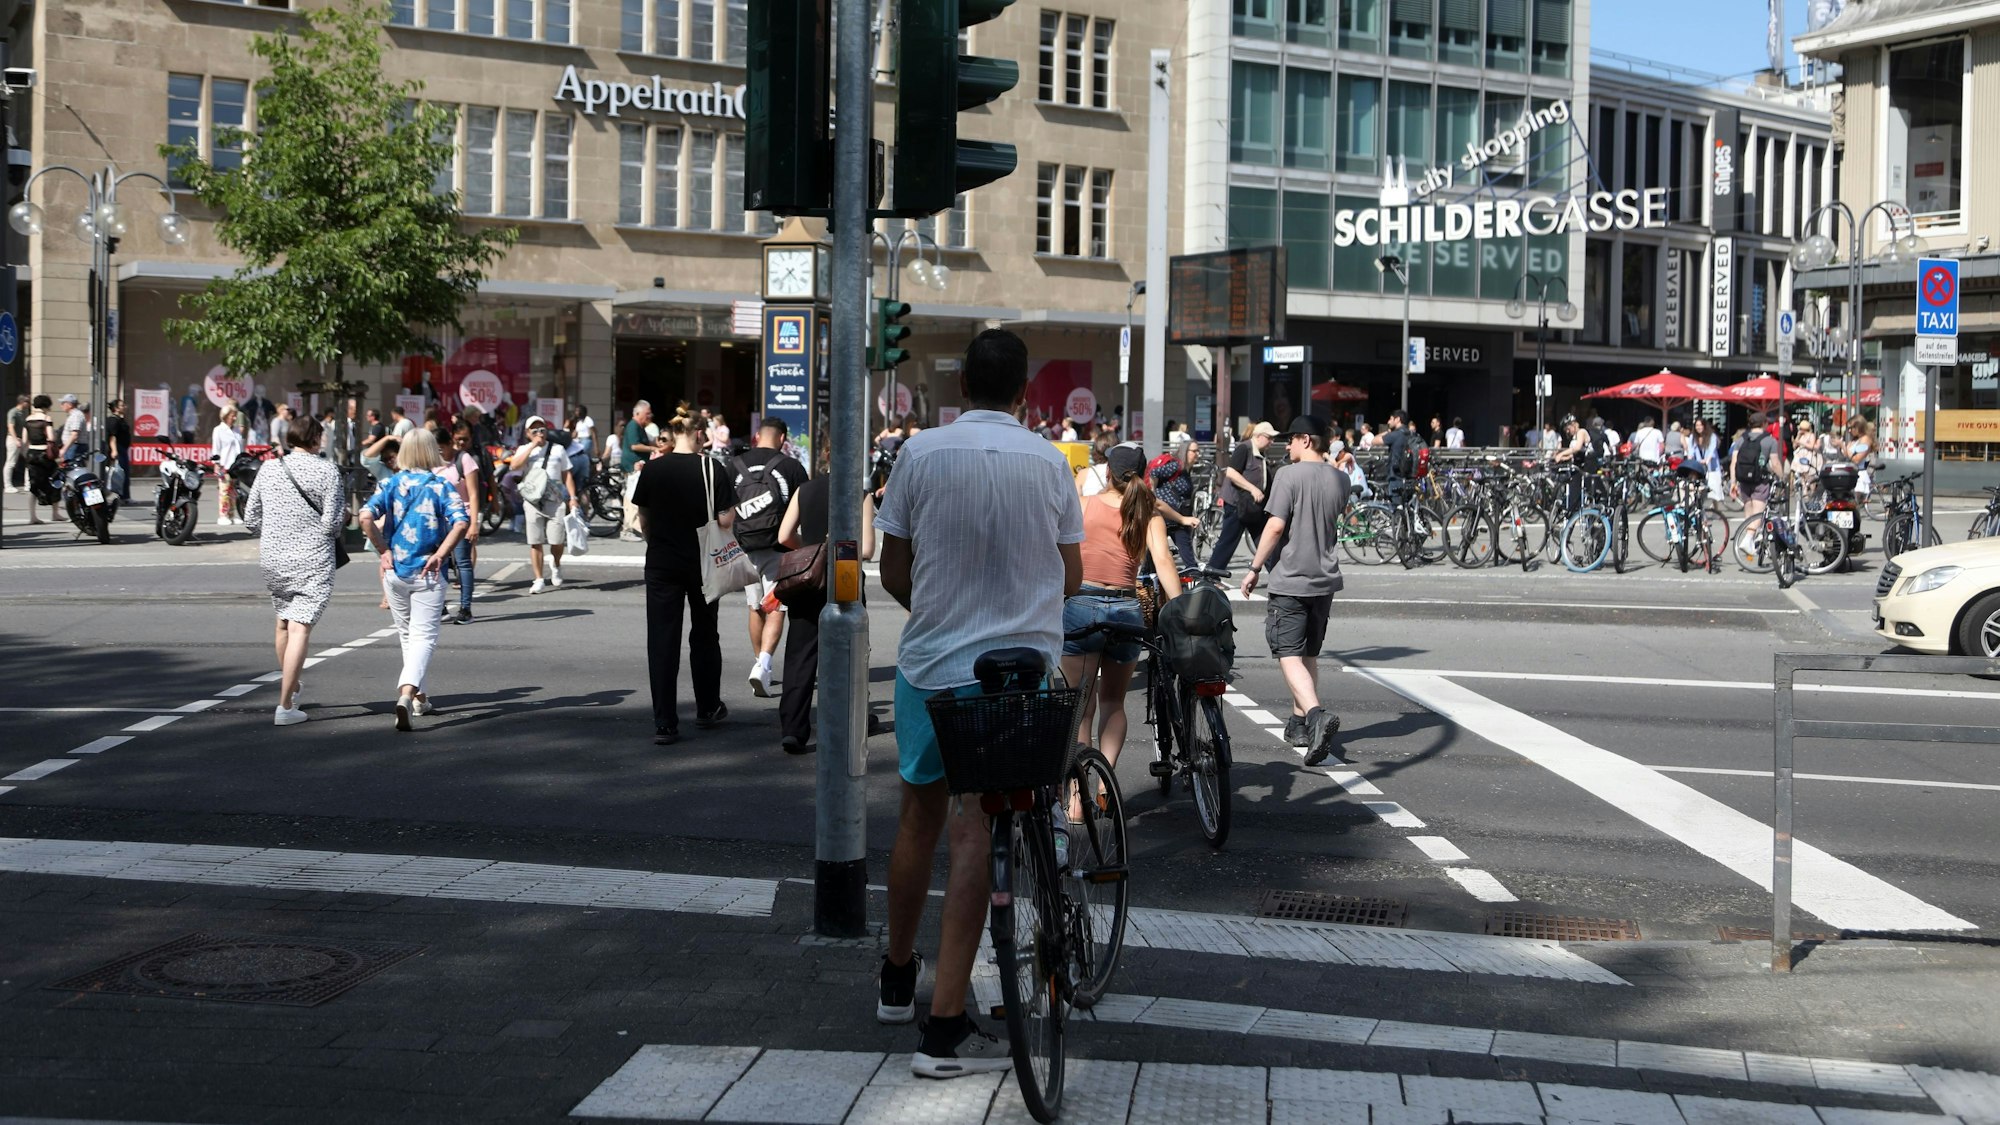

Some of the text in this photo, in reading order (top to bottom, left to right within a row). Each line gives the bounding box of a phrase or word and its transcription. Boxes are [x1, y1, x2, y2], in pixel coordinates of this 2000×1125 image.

[1414, 98, 1571, 197] city shopping
[1714, 144, 1734, 196] snipes
[1333, 186, 1667, 248] SCHILDERGASSE
[1715, 242, 1729, 351] RESERVED
[1920, 311, 1954, 330] TAXI
[779, 336, 799, 344] ALDI
[1925, 342, 1948, 350] auf dem
[1264, 348, 1303, 362] U Neumarkt
[1424, 346, 1480, 363] SERVED
[1918, 351, 1954, 360] Seitenstreifen
[767, 363, 805, 378] Frische
[209, 382, 247, 398] -50%
[464, 388, 498, 404] -50%
[769, 384, 783, 392] Nur
[783, 384, 797, 392] 200
[1069, 401, 1092, 416] -50%
[734, 490, 774, 520] VANS
